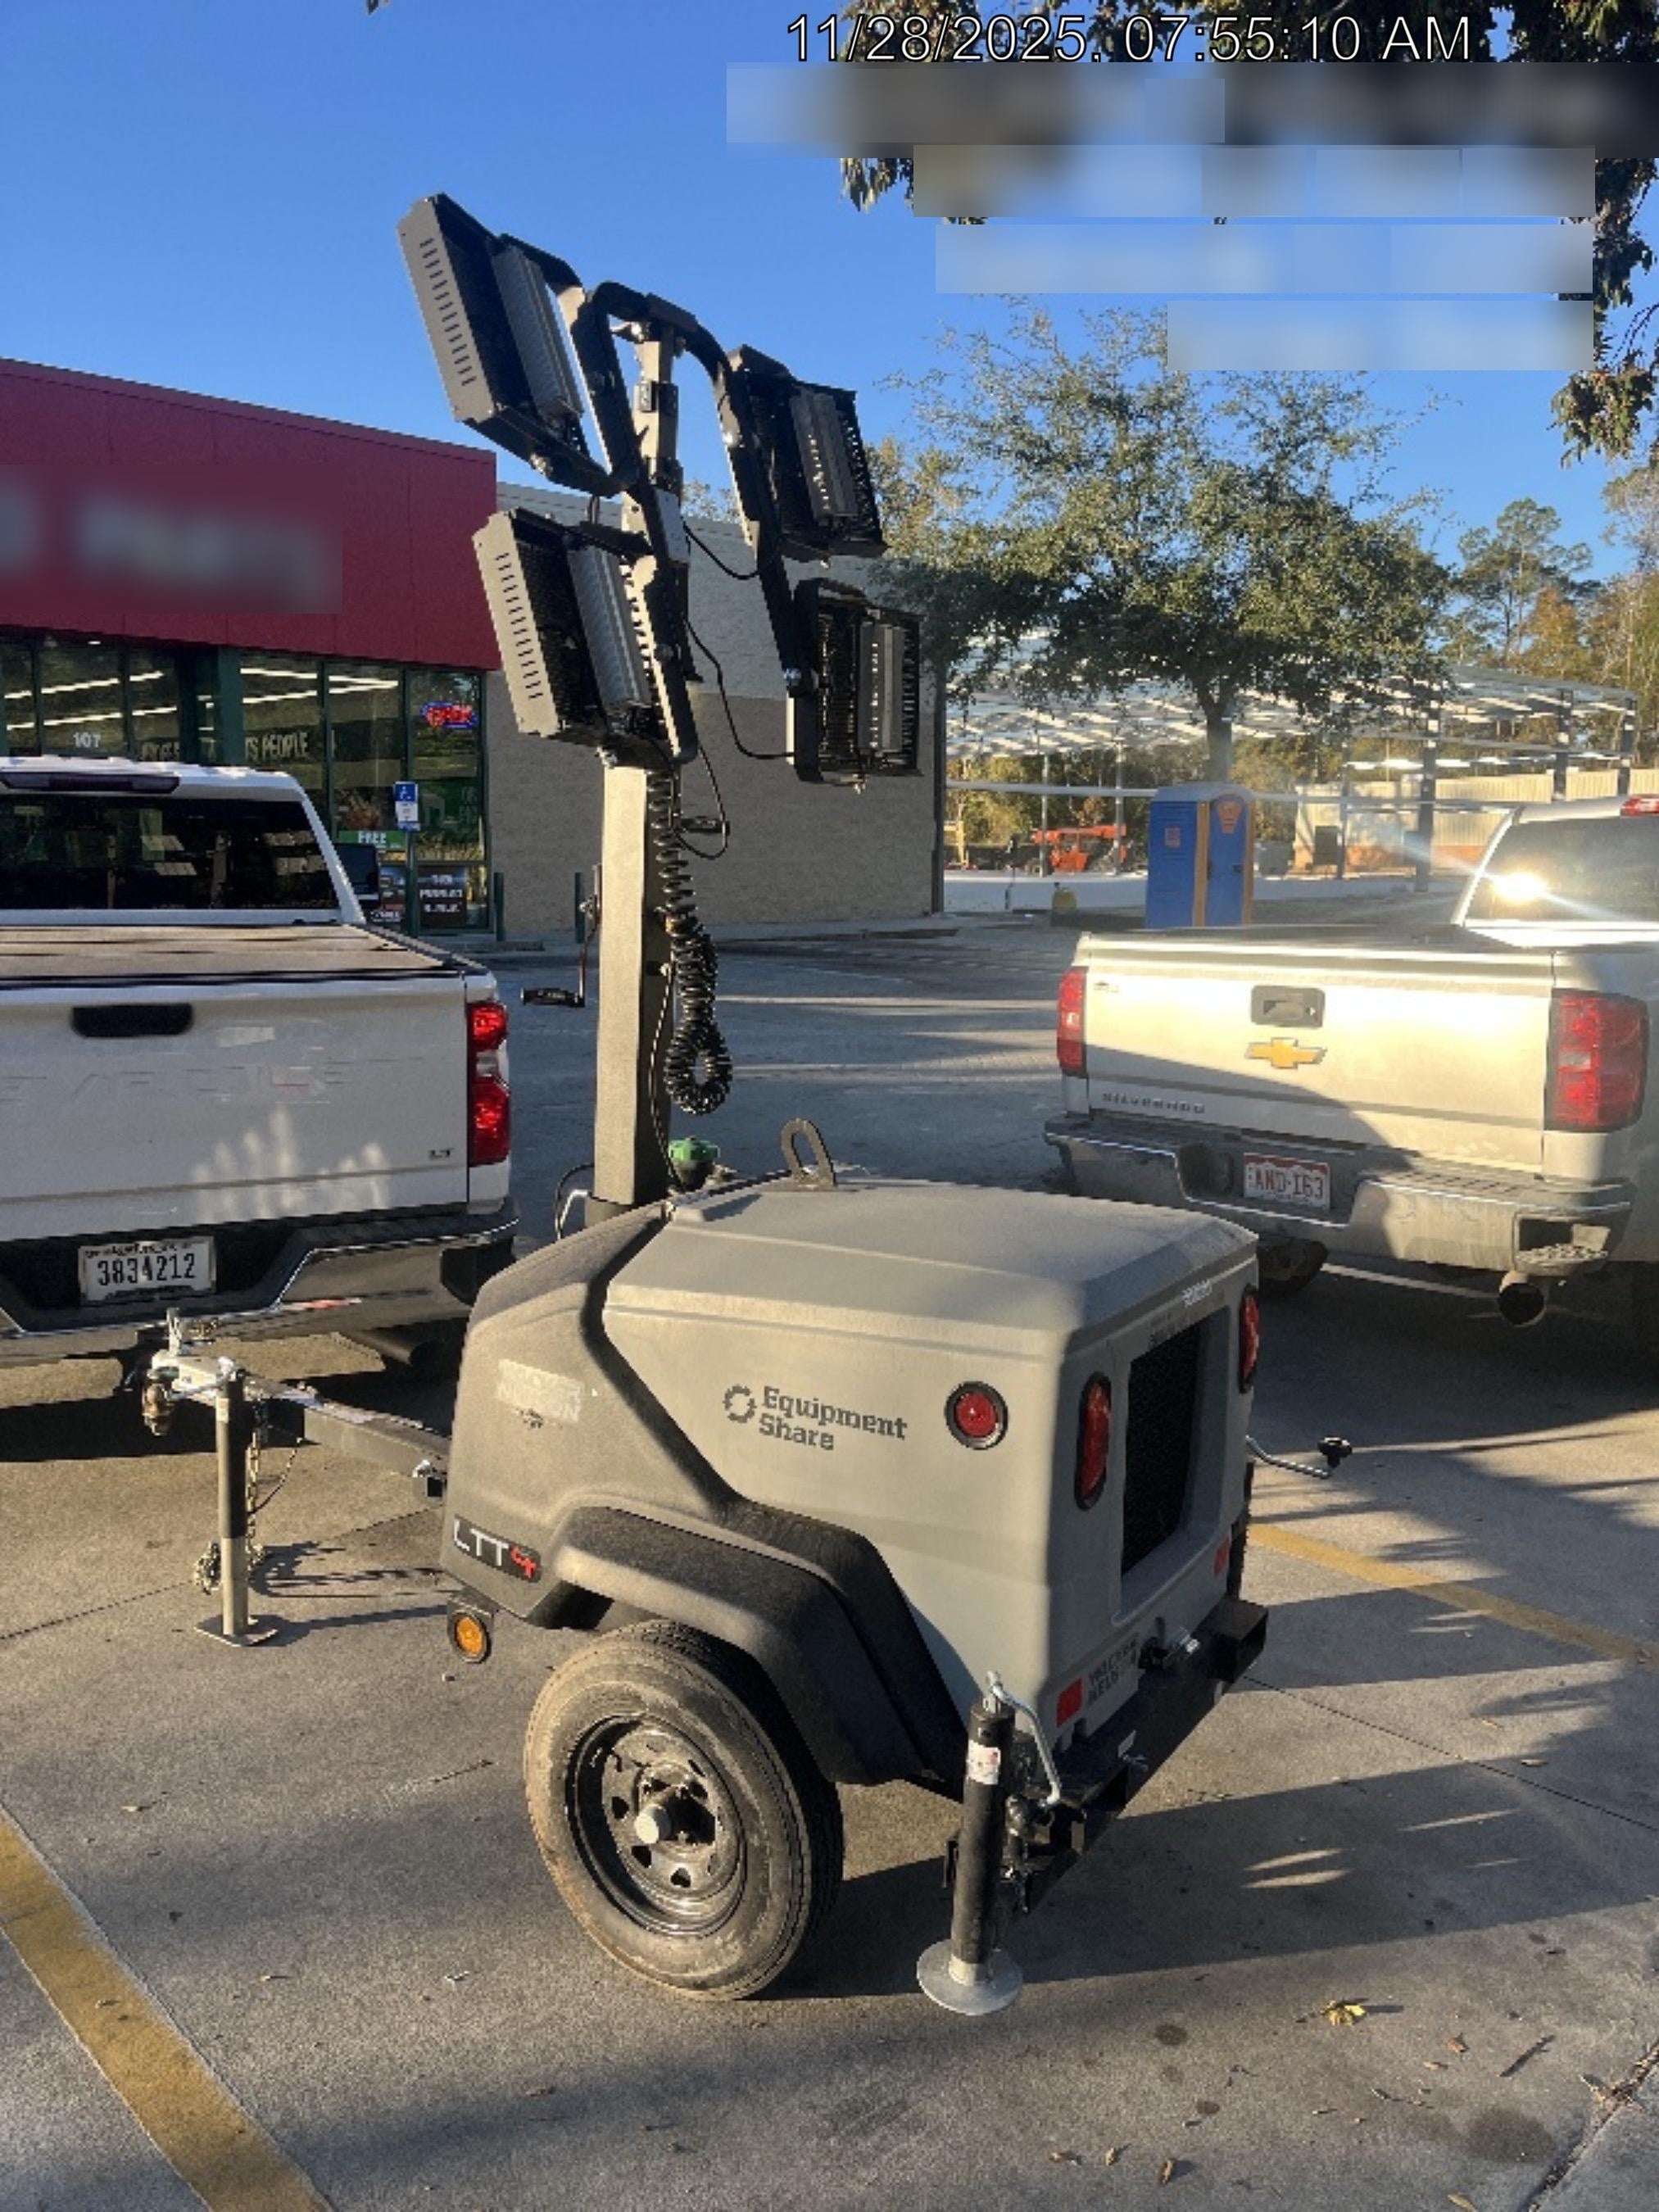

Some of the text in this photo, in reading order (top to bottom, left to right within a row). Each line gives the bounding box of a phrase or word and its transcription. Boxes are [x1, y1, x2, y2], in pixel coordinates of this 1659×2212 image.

[73, 732, 101, 748] 107
[97, 1253, 195, 1286] 3834212
[762, 1385, 908, 1440] Equipment
[759, 1412, 834, 1450] Share
